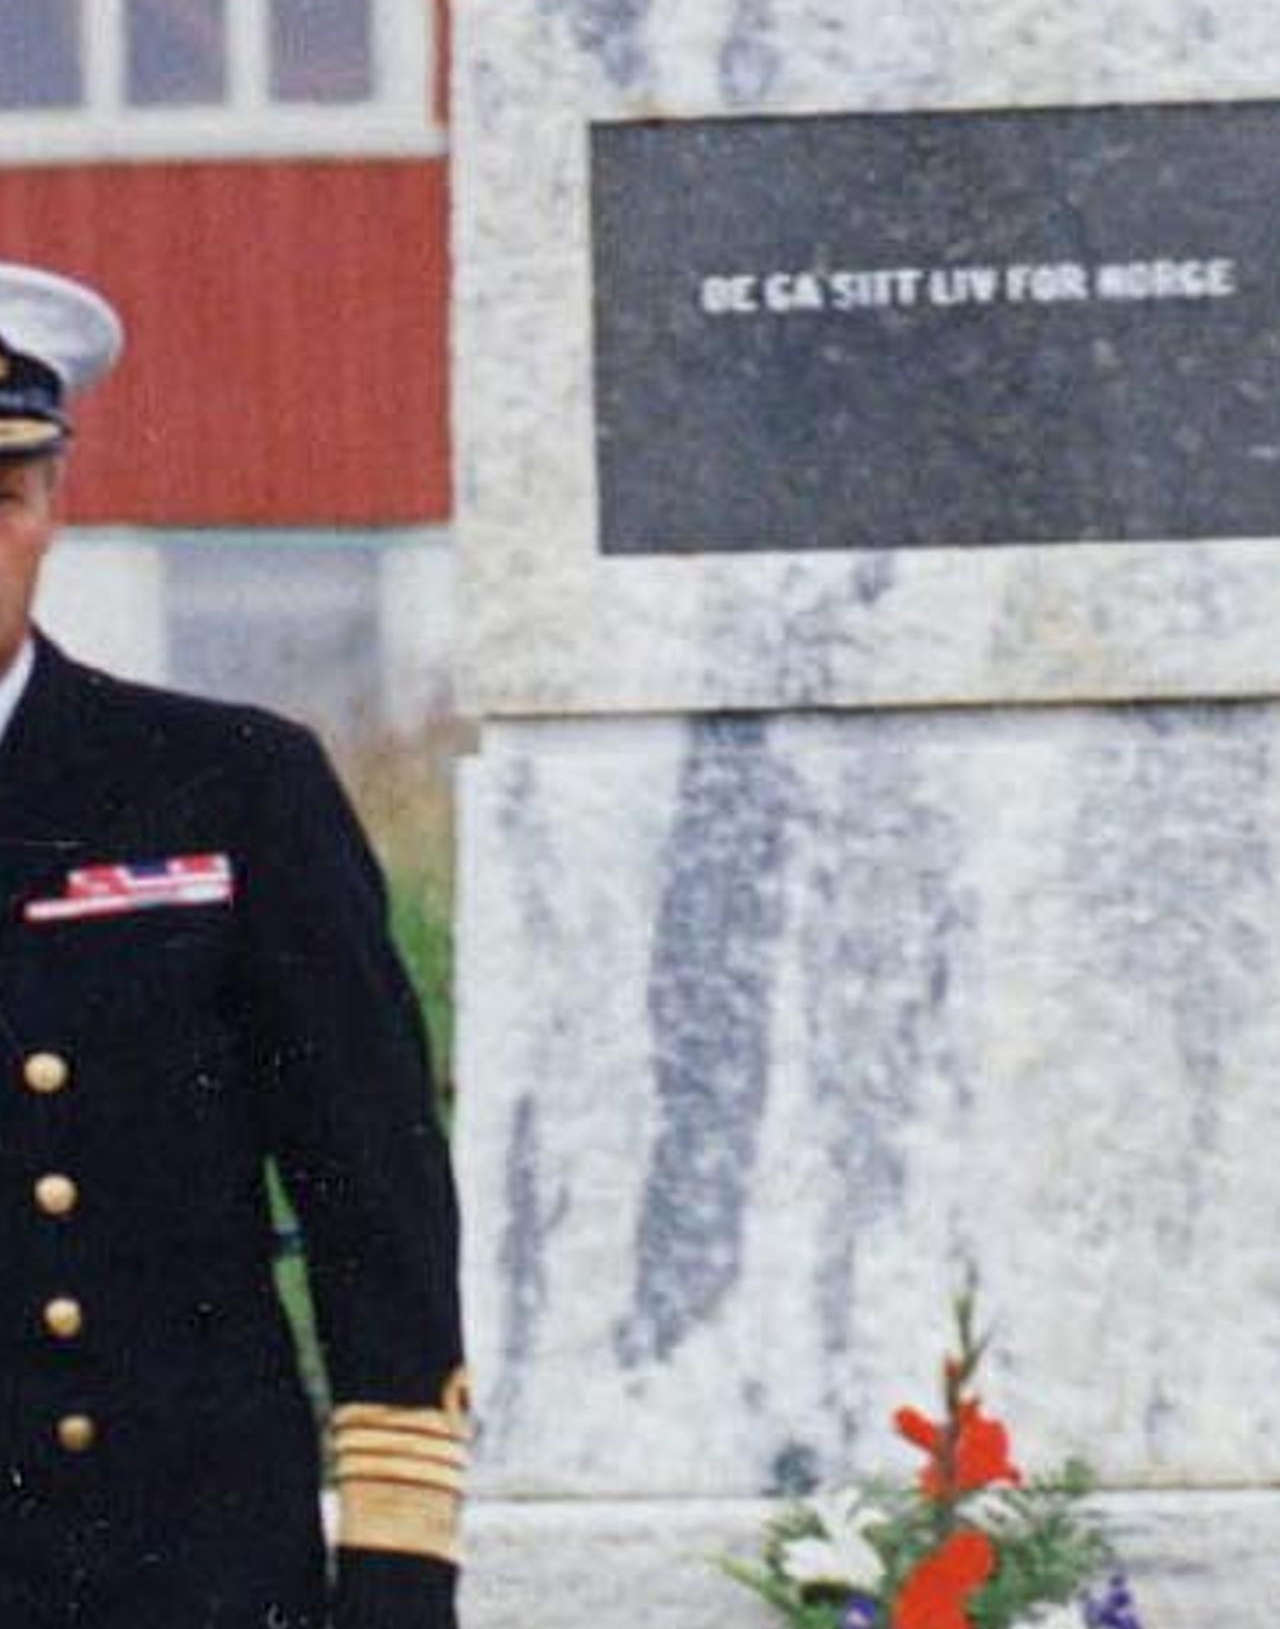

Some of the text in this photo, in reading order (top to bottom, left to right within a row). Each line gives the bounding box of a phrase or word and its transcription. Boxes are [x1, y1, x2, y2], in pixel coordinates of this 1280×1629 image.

[765, 274, 822, 311] GA
[830, 270, 922, 309] SITT
[930, 270, 996, 305] LIV
[1007, 264, 1088, 302] FOR
